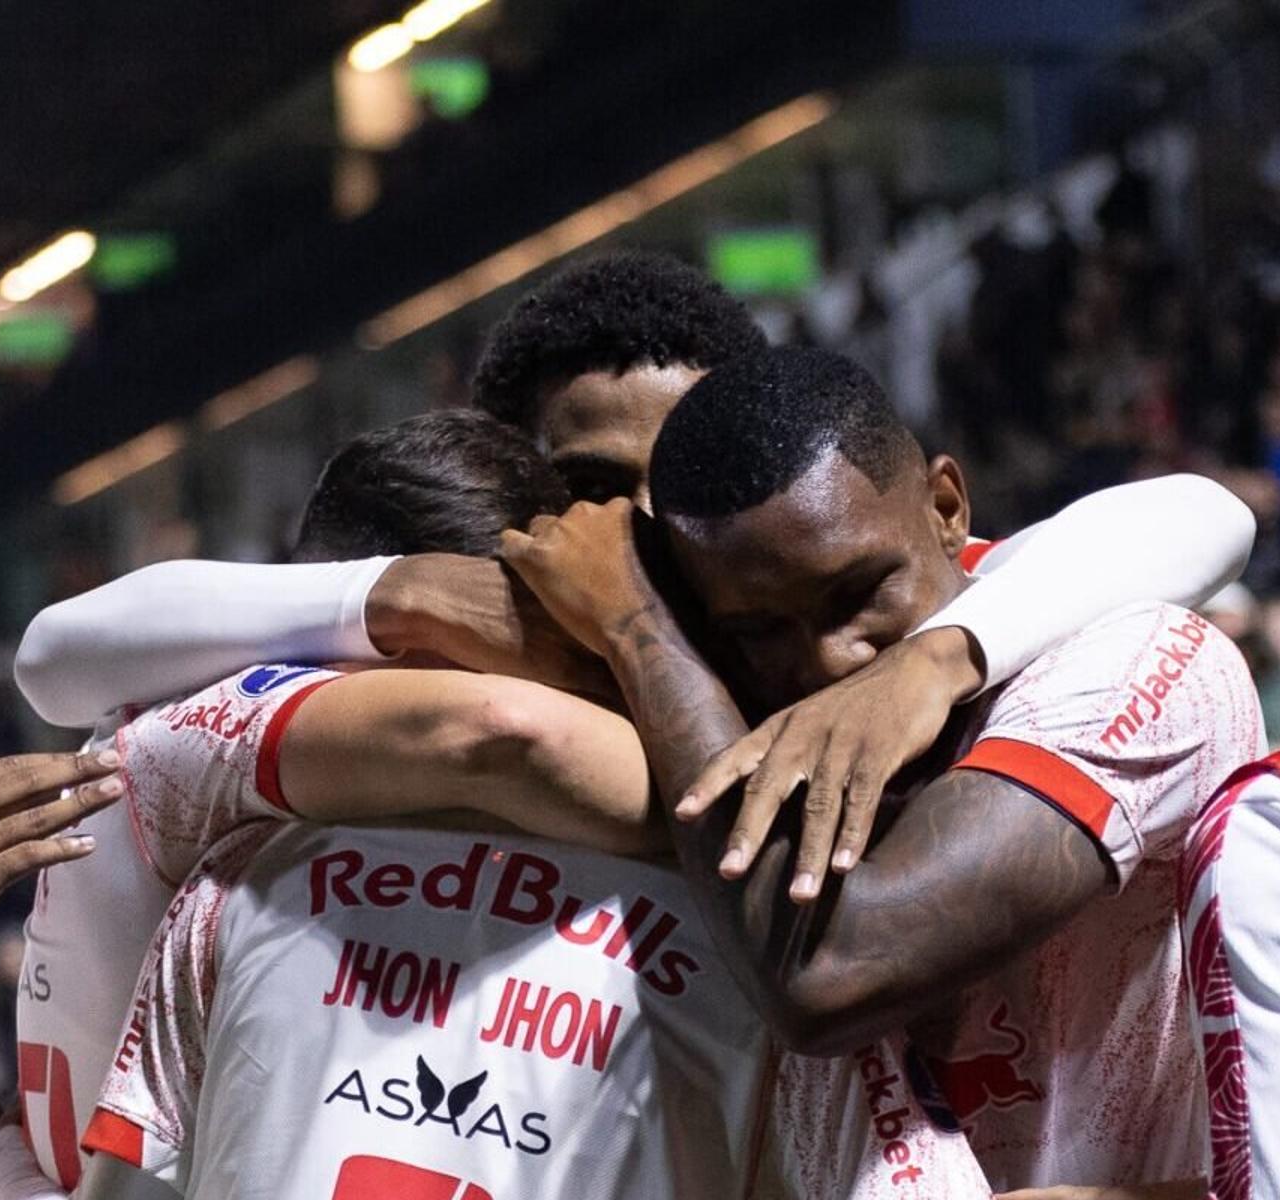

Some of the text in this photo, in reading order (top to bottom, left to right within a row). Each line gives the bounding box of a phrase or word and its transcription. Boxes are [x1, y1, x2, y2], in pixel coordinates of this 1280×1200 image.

[1099, 612, 1208, 755] mrJack.be
[322, 939, 623, 1072] JHON JHON
[853, 1045, 924, 1186] ck.bet
